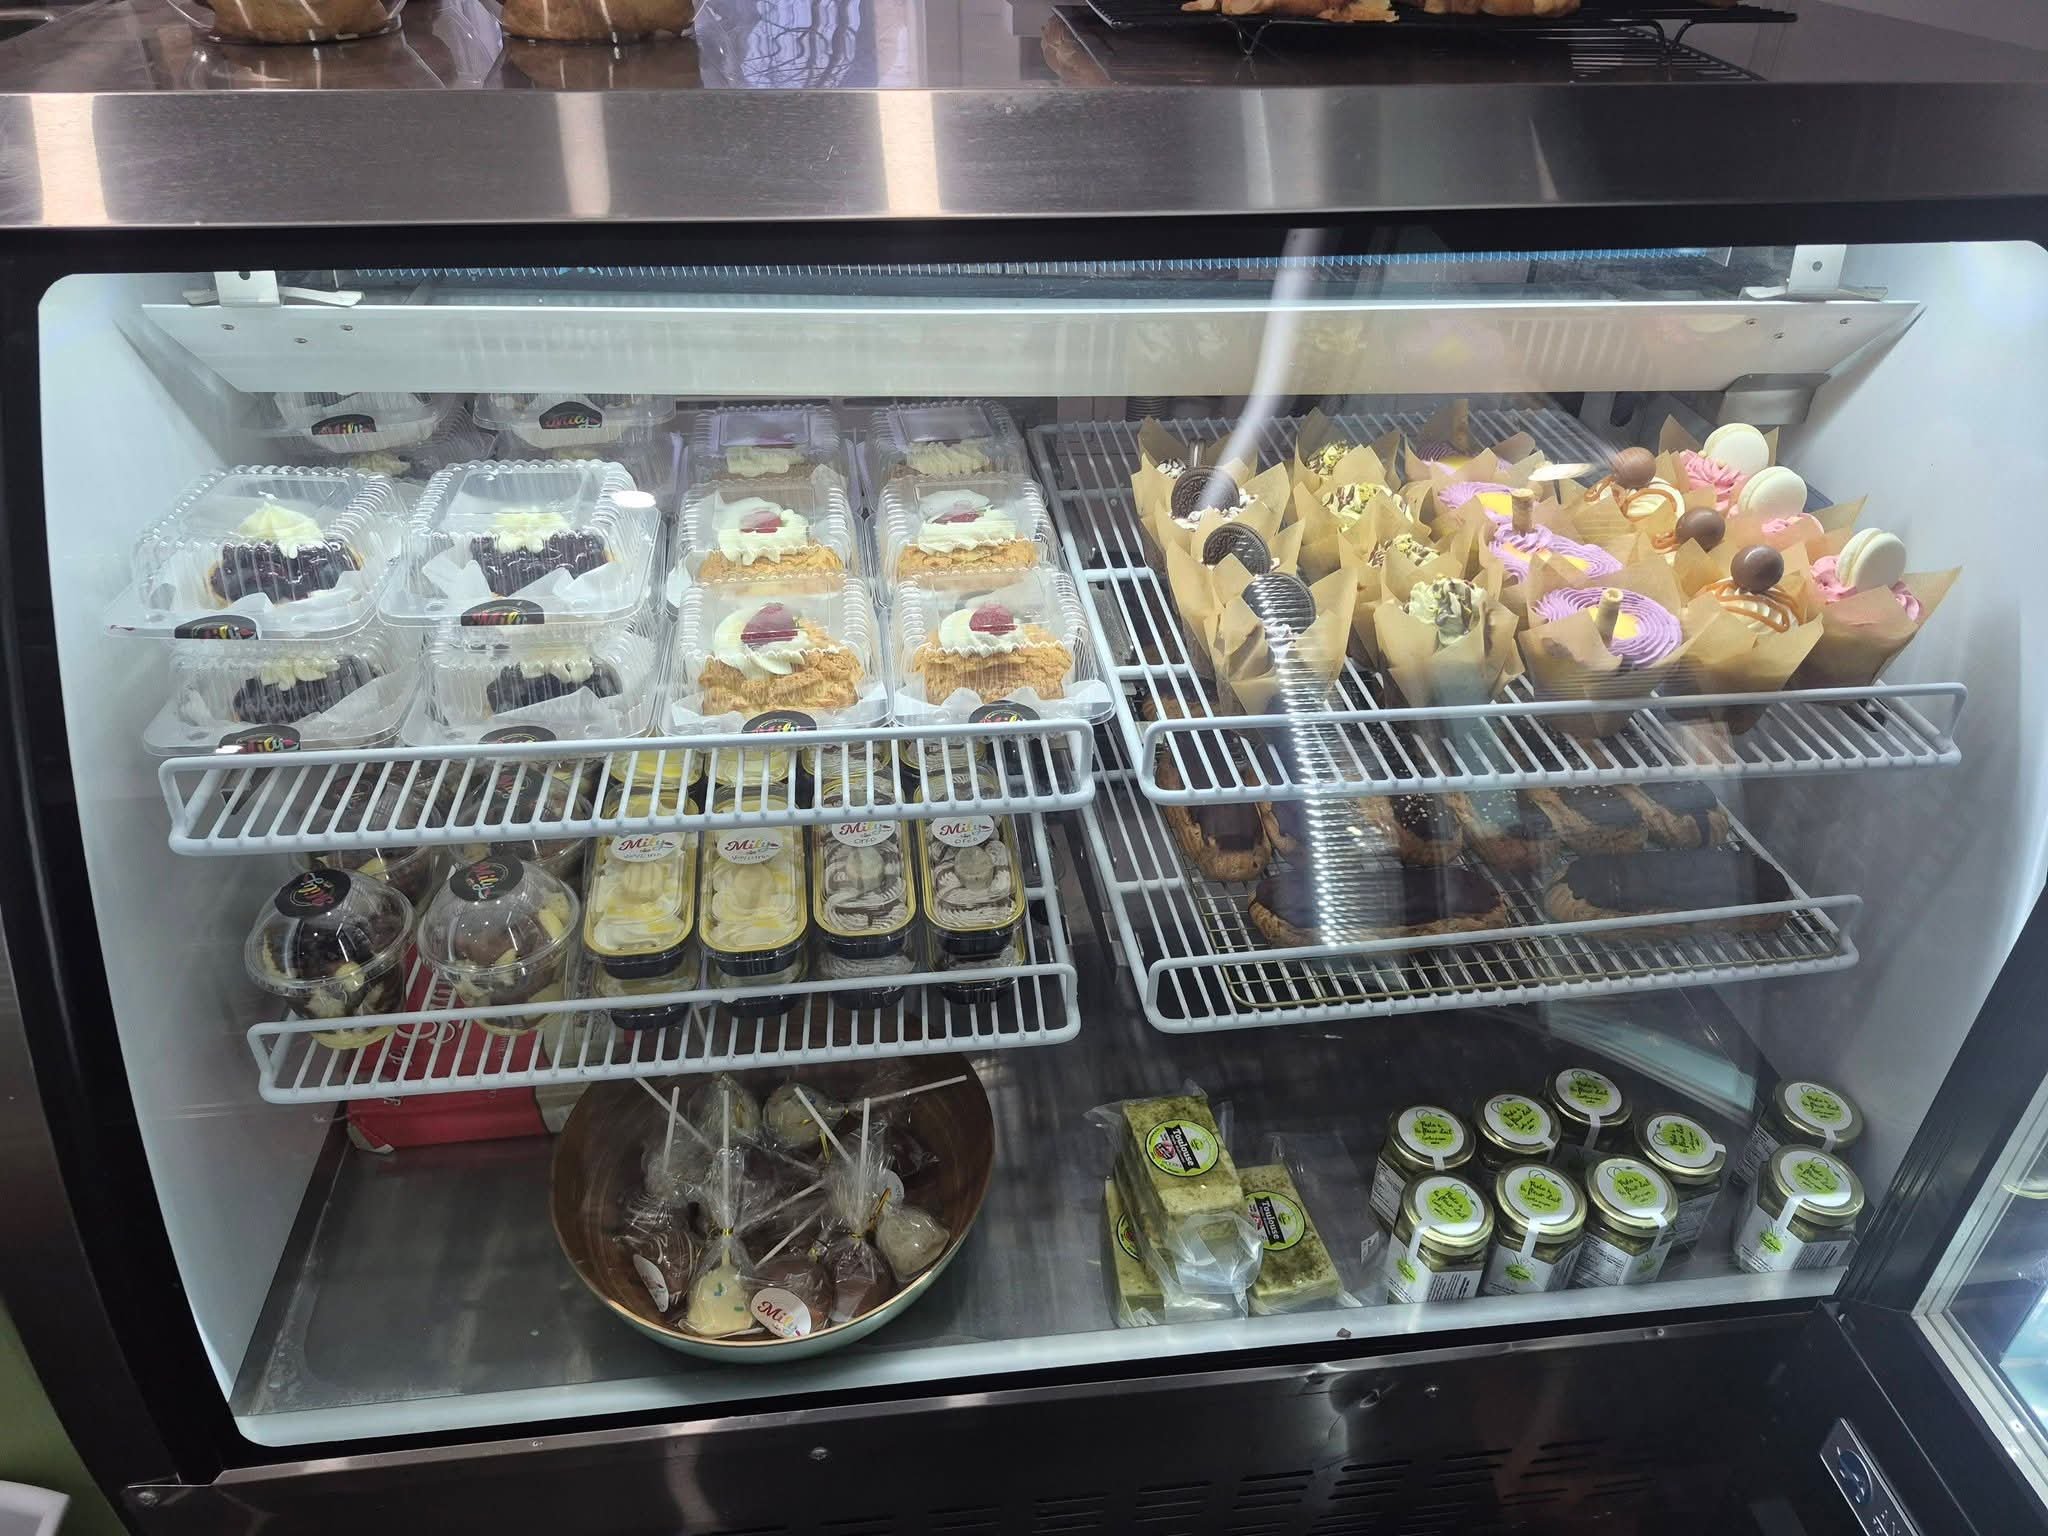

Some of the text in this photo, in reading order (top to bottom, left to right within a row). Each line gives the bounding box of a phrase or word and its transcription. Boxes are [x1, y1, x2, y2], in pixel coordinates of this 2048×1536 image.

[940, 817, 995, 837] Mily
[618, 836, 674, 852] Mily
[724, 837, 780, 853] Mily
[1172, 1128, 1195, 1167] Toulouse
[1262, 1201, 1280, 1240] Toulouse
